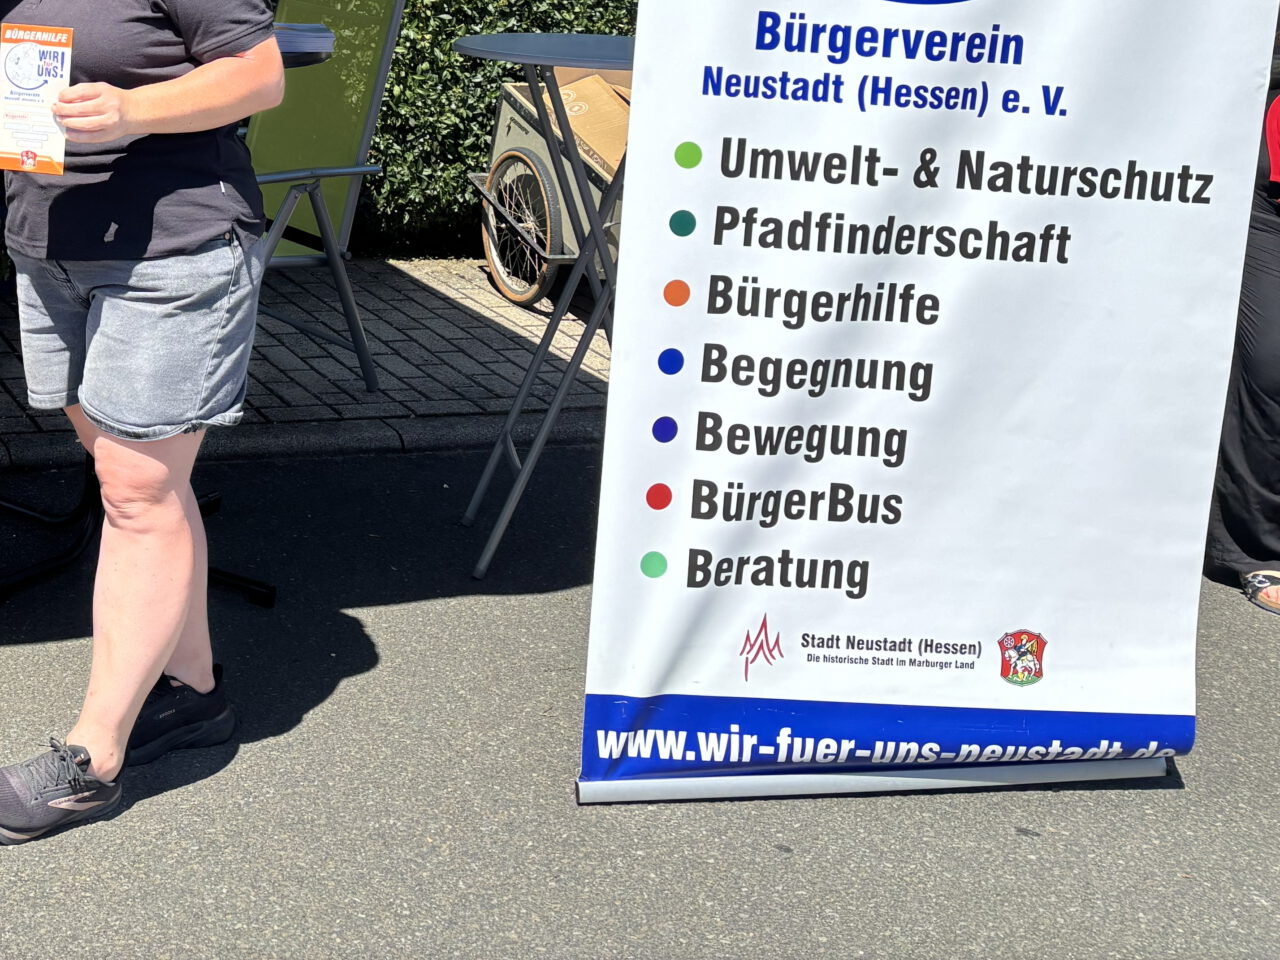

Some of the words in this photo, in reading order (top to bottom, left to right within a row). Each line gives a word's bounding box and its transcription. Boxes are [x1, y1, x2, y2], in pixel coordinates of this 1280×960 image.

[5, 28, 68, 43] BÜRGERHILFE
[38, 49, 59, 63] WIR
[755, 10, 1024, 65] Bürgerverein
[702, 65, 844, 104] Neustadt
[857, 75, 989, 118] (Hessen)
[1001, 89, 1030, 114] e.
[1041, 85, 1067, 117] V.
[720, 137, 899, 187] Umwelt-
[913, 147, 940, 189] &
[956, 149, 1214, 205] Naturschutz
[713, 205, 1072, 264] Pfadfinderschaft
[707, 274, 940, 330] Bürgerhilfe
[701, 343, 933, 402] Begegnung
[695, 411, 908, 468] Bewegung
[690, 478, 903, 529] BürgerBus
[686, 548, 869, 600] Beratung
[801, 633, 841, 649] Stadt
[846, 635, 913, 653] Neustadt
[918, 638, 982, 659] (Hessen)
[806, 653, 820, 663] Die
[822, 654, 869, 665] historische
[871, 656, 894, 666] Stadt
[896, 657, 907, 667] im
[908, 658, 953, 670] Marburger
[954, 660, 975, 670] Land
